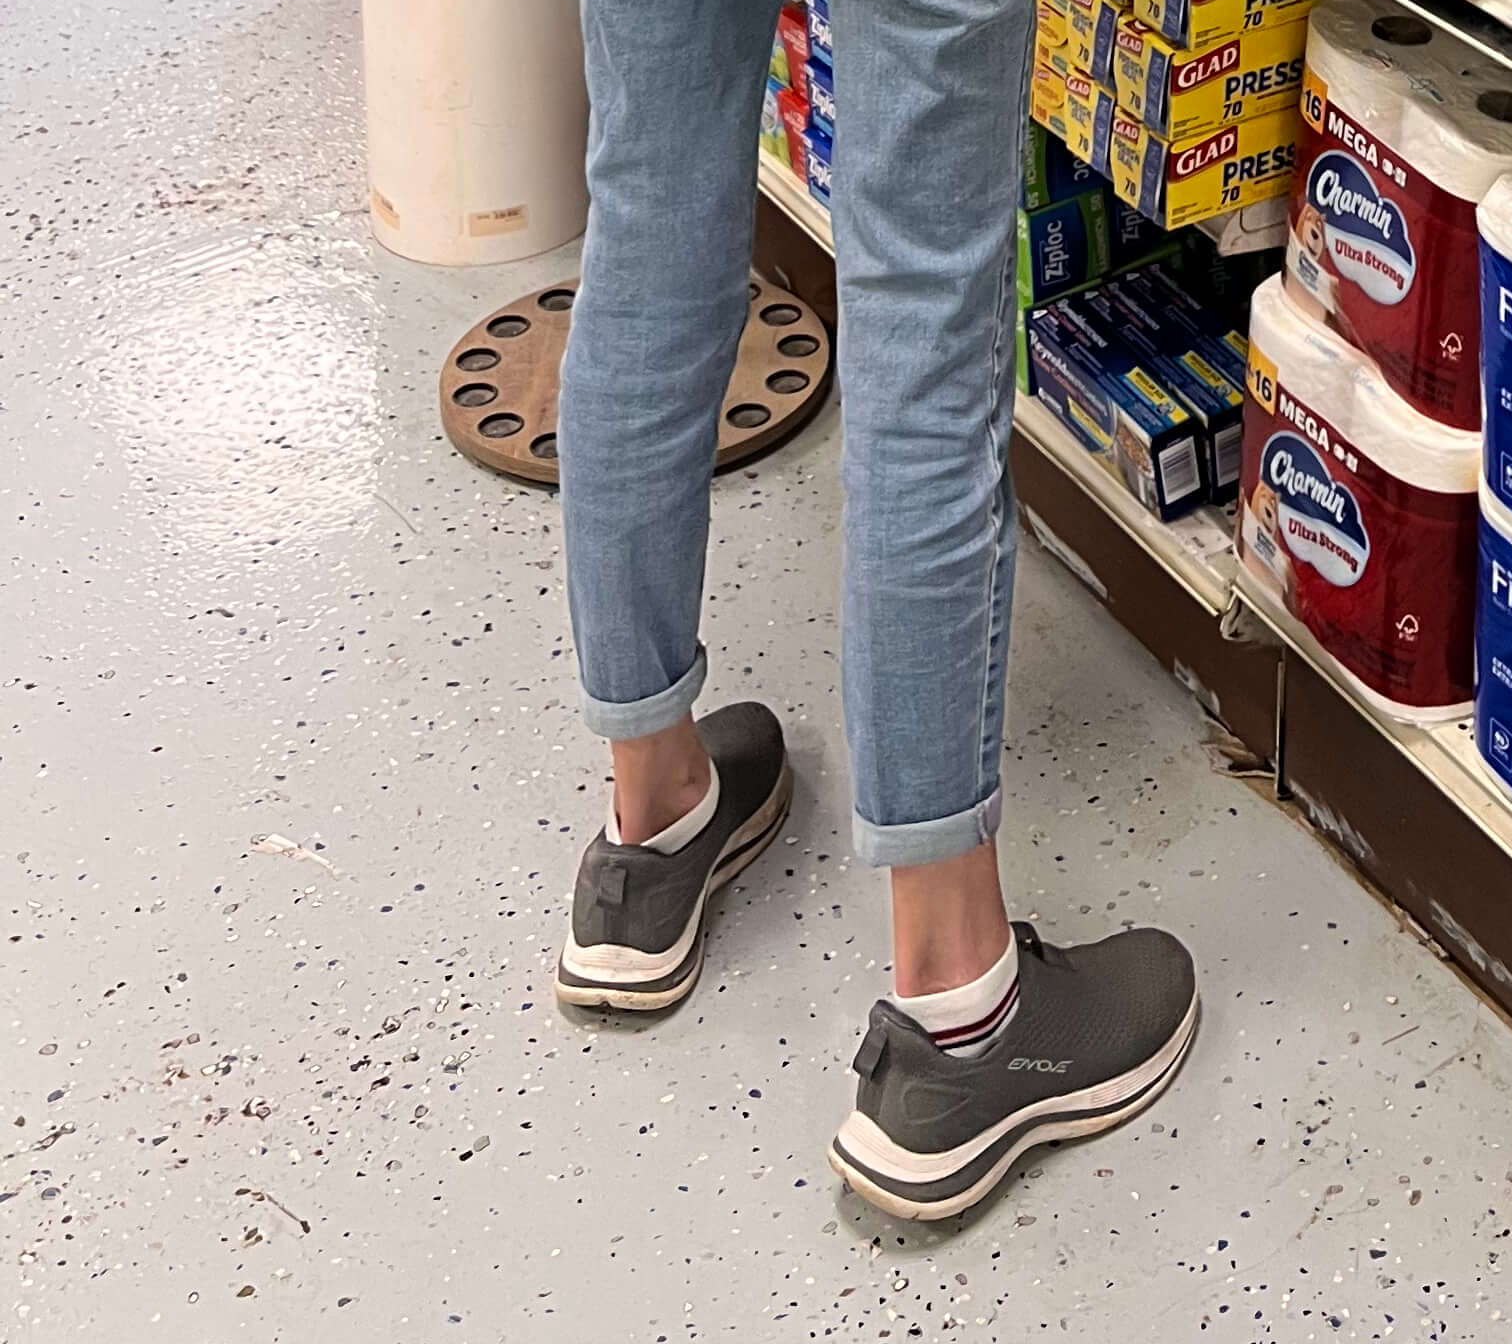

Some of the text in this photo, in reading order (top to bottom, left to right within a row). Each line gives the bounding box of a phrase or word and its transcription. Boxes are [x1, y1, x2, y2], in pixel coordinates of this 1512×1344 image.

[1177, 47, 1238, 89] GLAD
[1224, 102, 1242, 118] 70
[1304, 89, 1322, 123] 16
[1176, 134, 1235, 175] GLAD
[1328, 112, 1378, 168] MEGA
[1221, 187, 1239, 204] 70
[1316, 169, 1393, 240] Charmin
[1045, 219, 1070, 282] Ziploc
[1335, 237, 1405, 291] Ultra Strong
[1280, 393, 1330, 452] MEGA
[1270, 450, 1345, 523] Charmin
[1289, 518, 1358, 573] Ultra Strong
